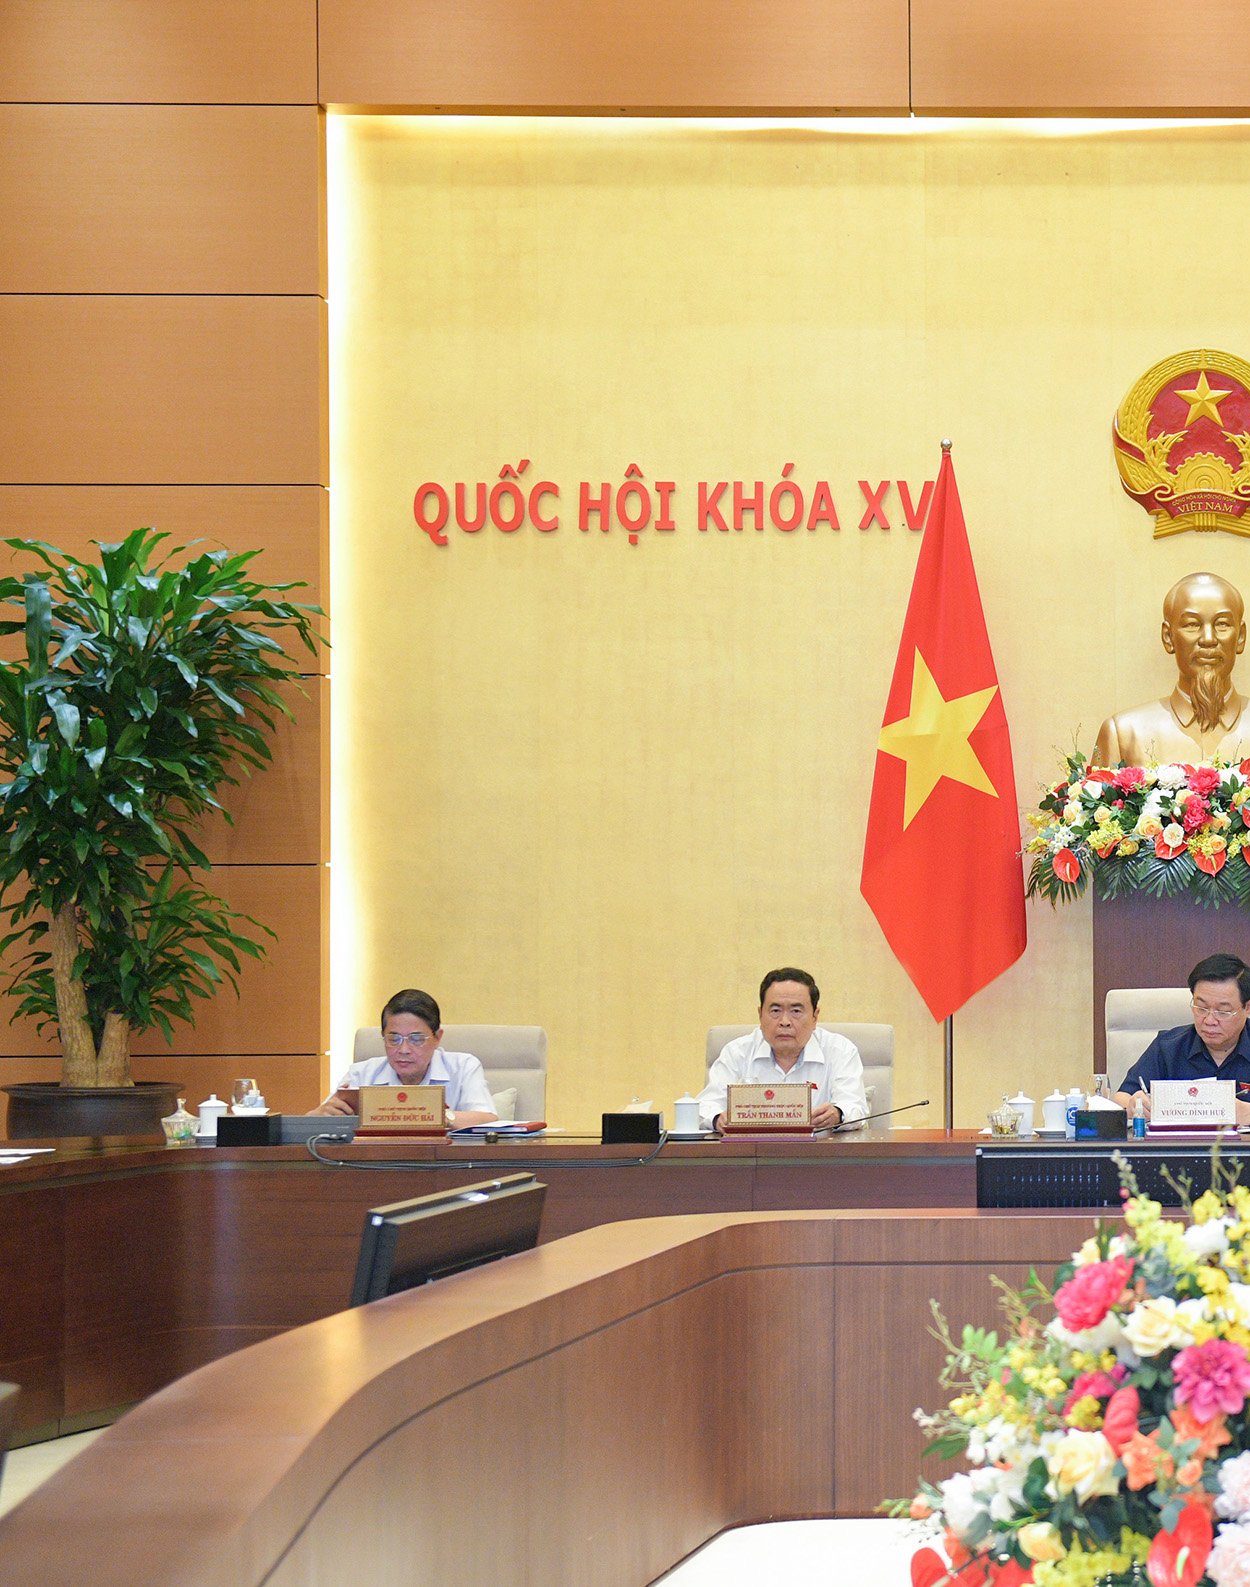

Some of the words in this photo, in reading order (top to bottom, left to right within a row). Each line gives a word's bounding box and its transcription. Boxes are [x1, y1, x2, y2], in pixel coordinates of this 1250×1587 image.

[413, 459, 559, 545] QUỐC
[578, 463, 676, 545] HỘI
[698, 463, 841, 532] KHÓA
[858, 480, 935, 531] XV
[1178, 501, 1203, 512] VIỆT
[1205, 501, 1233, 512] NAM
